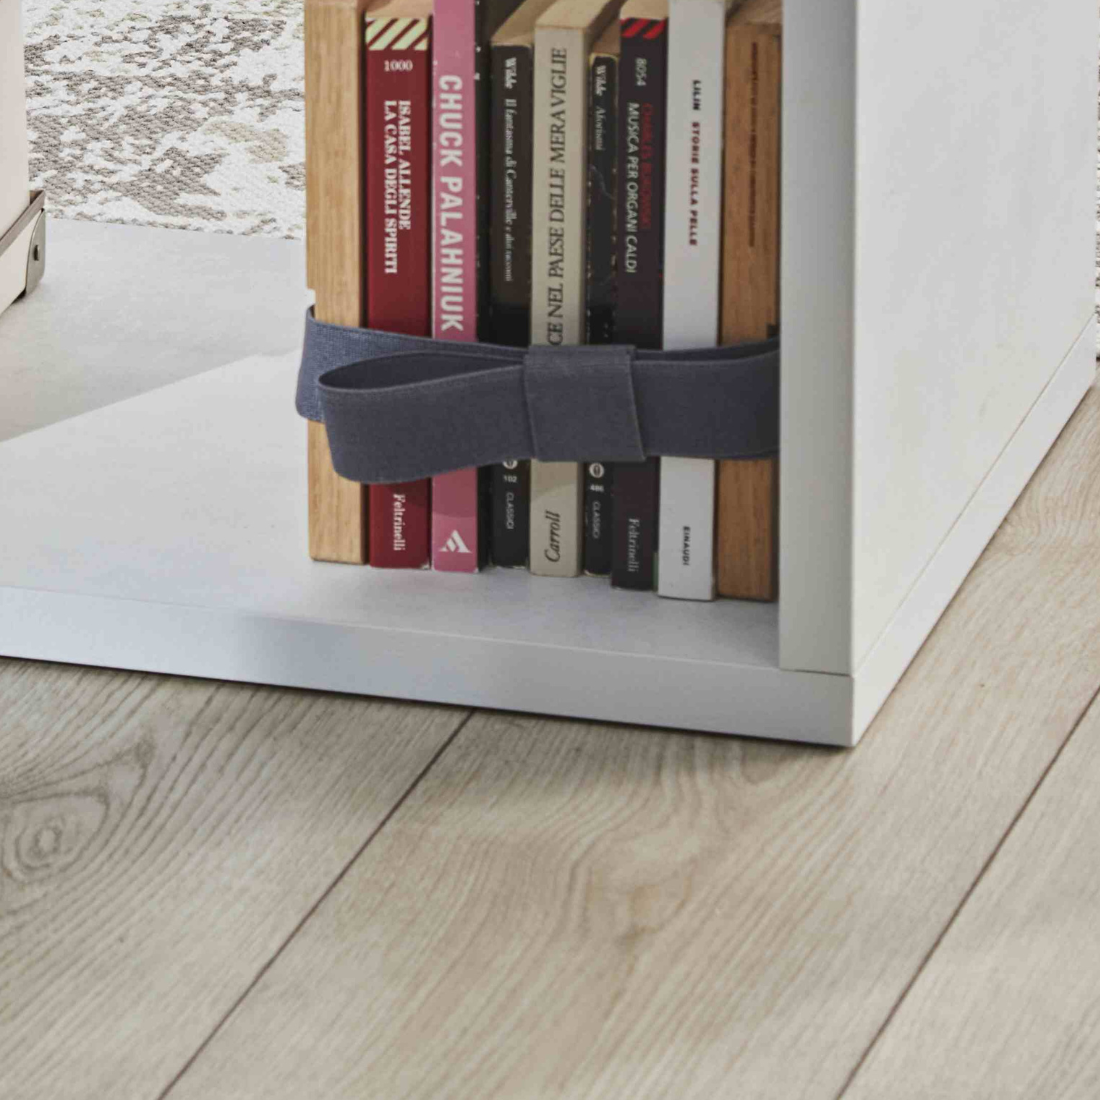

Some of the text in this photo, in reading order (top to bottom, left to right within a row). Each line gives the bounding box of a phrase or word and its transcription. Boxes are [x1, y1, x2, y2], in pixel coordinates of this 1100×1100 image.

[384, 60, 413, 71] 1000
[505, 57, 517, 89] Wilde
[635, 57, 647, 87] 8054
[505, 109, 517, 155] fantasma
[550, 48, 567, 164] MERAVIGLIE
[384, 100, 398, 274] LA CASA DEGLI SPIRITI
[398, 100, 411, 230] ISABEL ALLENDE
[505, 157, 517, 168] di
[625, 102, 640, 273] MUSICA PER ORGANI CALDI
[689, 80, 701, 246] LILIN STORIE SULLA PELLE
[439, 75, 463, 331] CHUCK PALAHNIUK
[504, 169, 517, 225] Canterville
[549, 169, 566, 224] DELLE
[548, 227, 565, 279] PAESE
[547, 284, 564, 319] NEL
[393, 493, 406, 551] Feltrinelli
[544, 510, 561, 563] Carroll
[628, 518, 640, 572] Feltrinelli
[682, 526, 691, 566] EINAUDI
